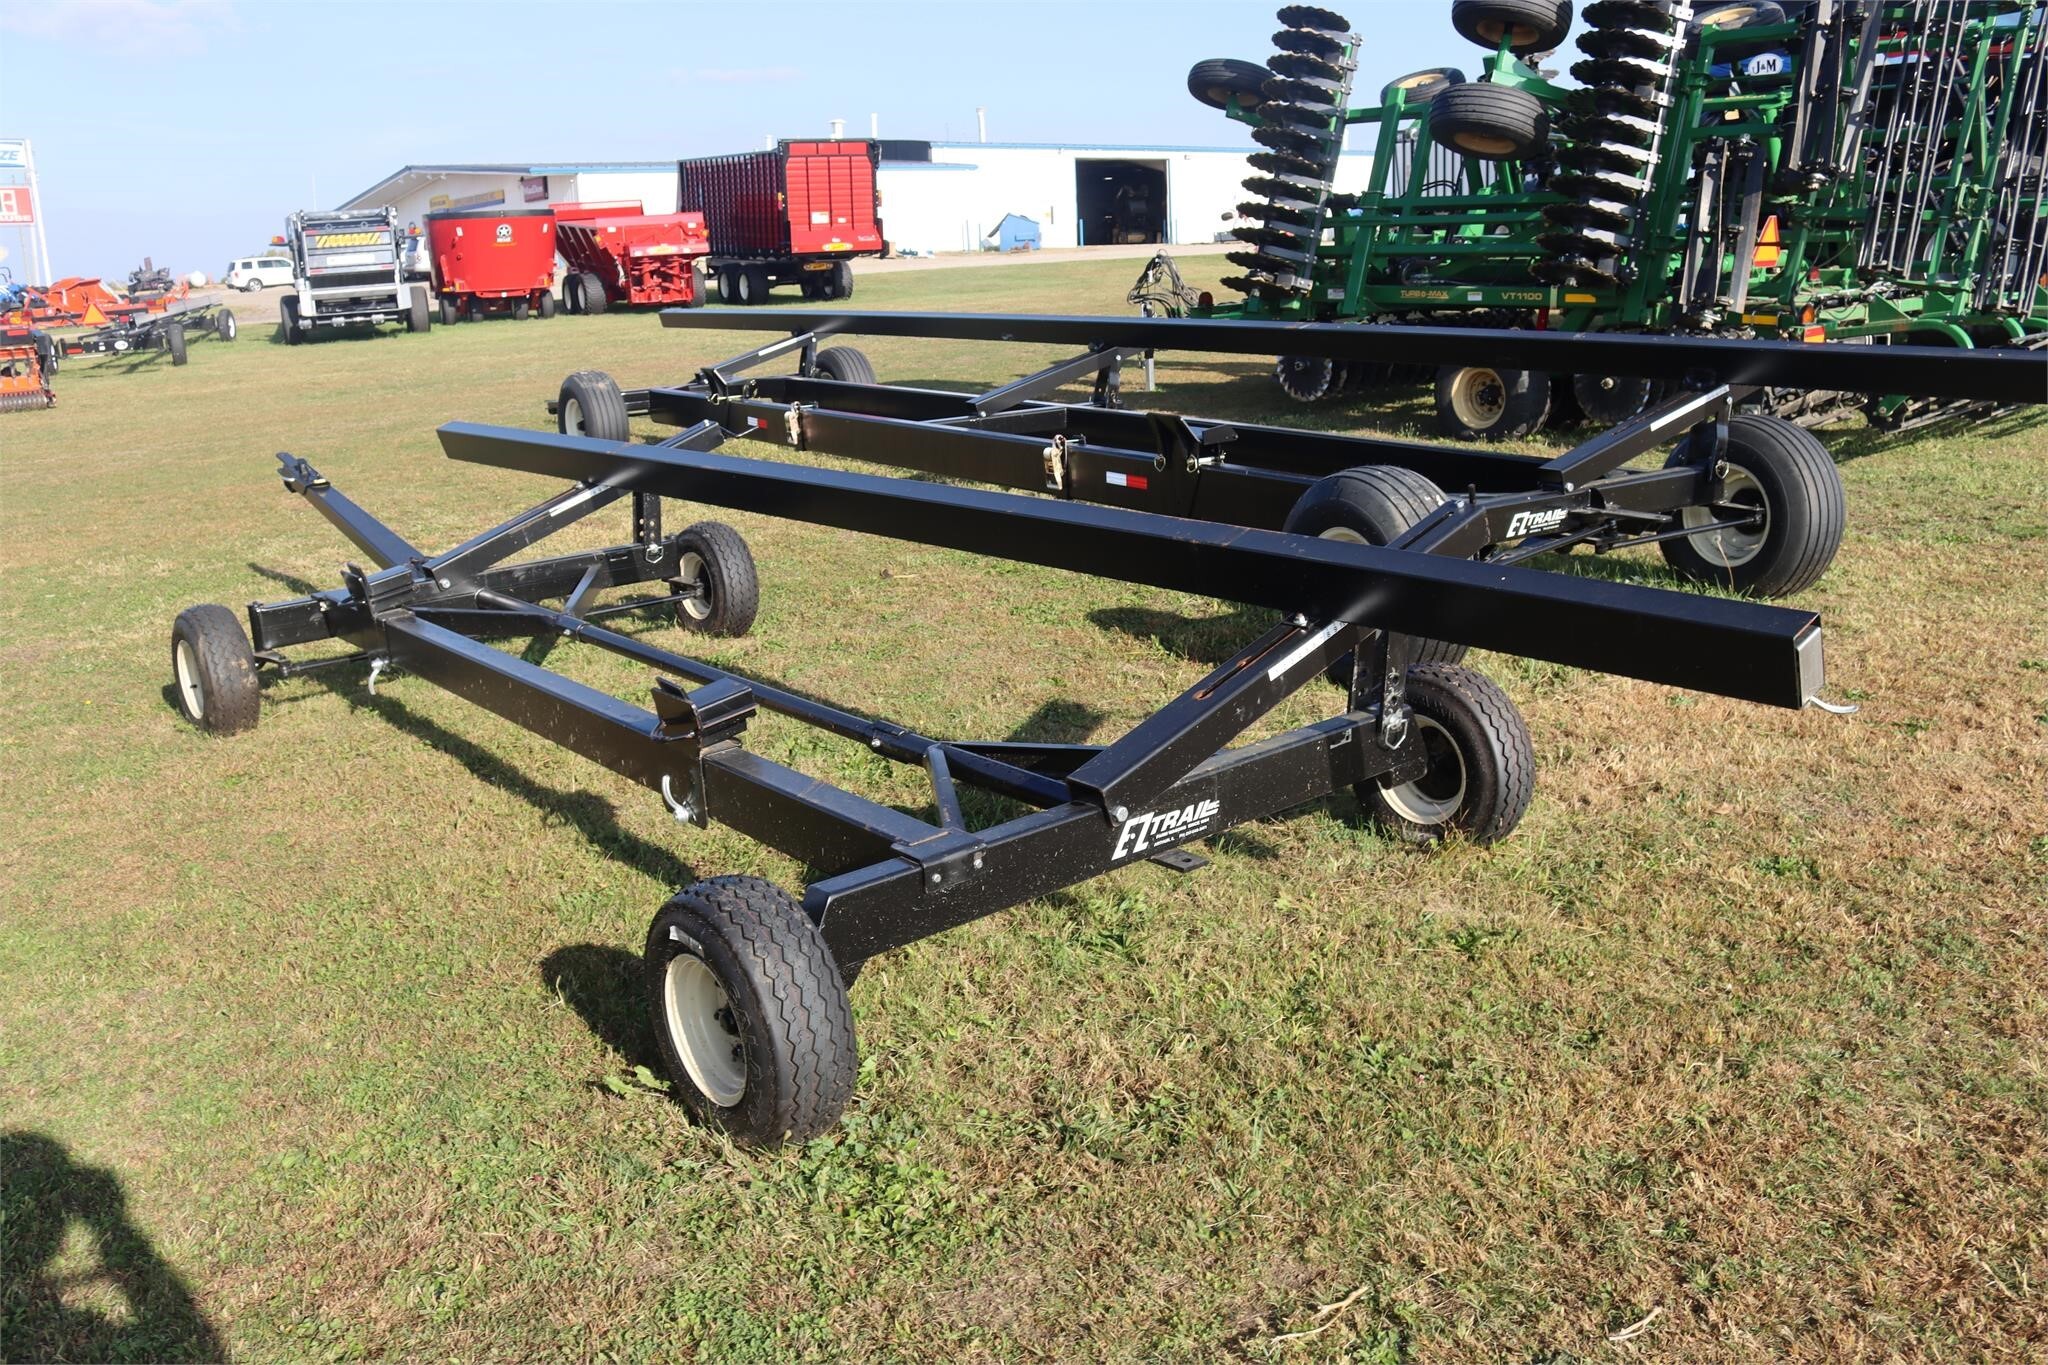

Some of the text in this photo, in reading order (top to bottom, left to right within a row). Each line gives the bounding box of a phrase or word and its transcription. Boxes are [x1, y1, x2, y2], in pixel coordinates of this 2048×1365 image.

[1752, 59, 1776, 74] J&M
[1501, 291, 1543, 300] VT1100
[1150, 799, 1219, 836] TRAIL
